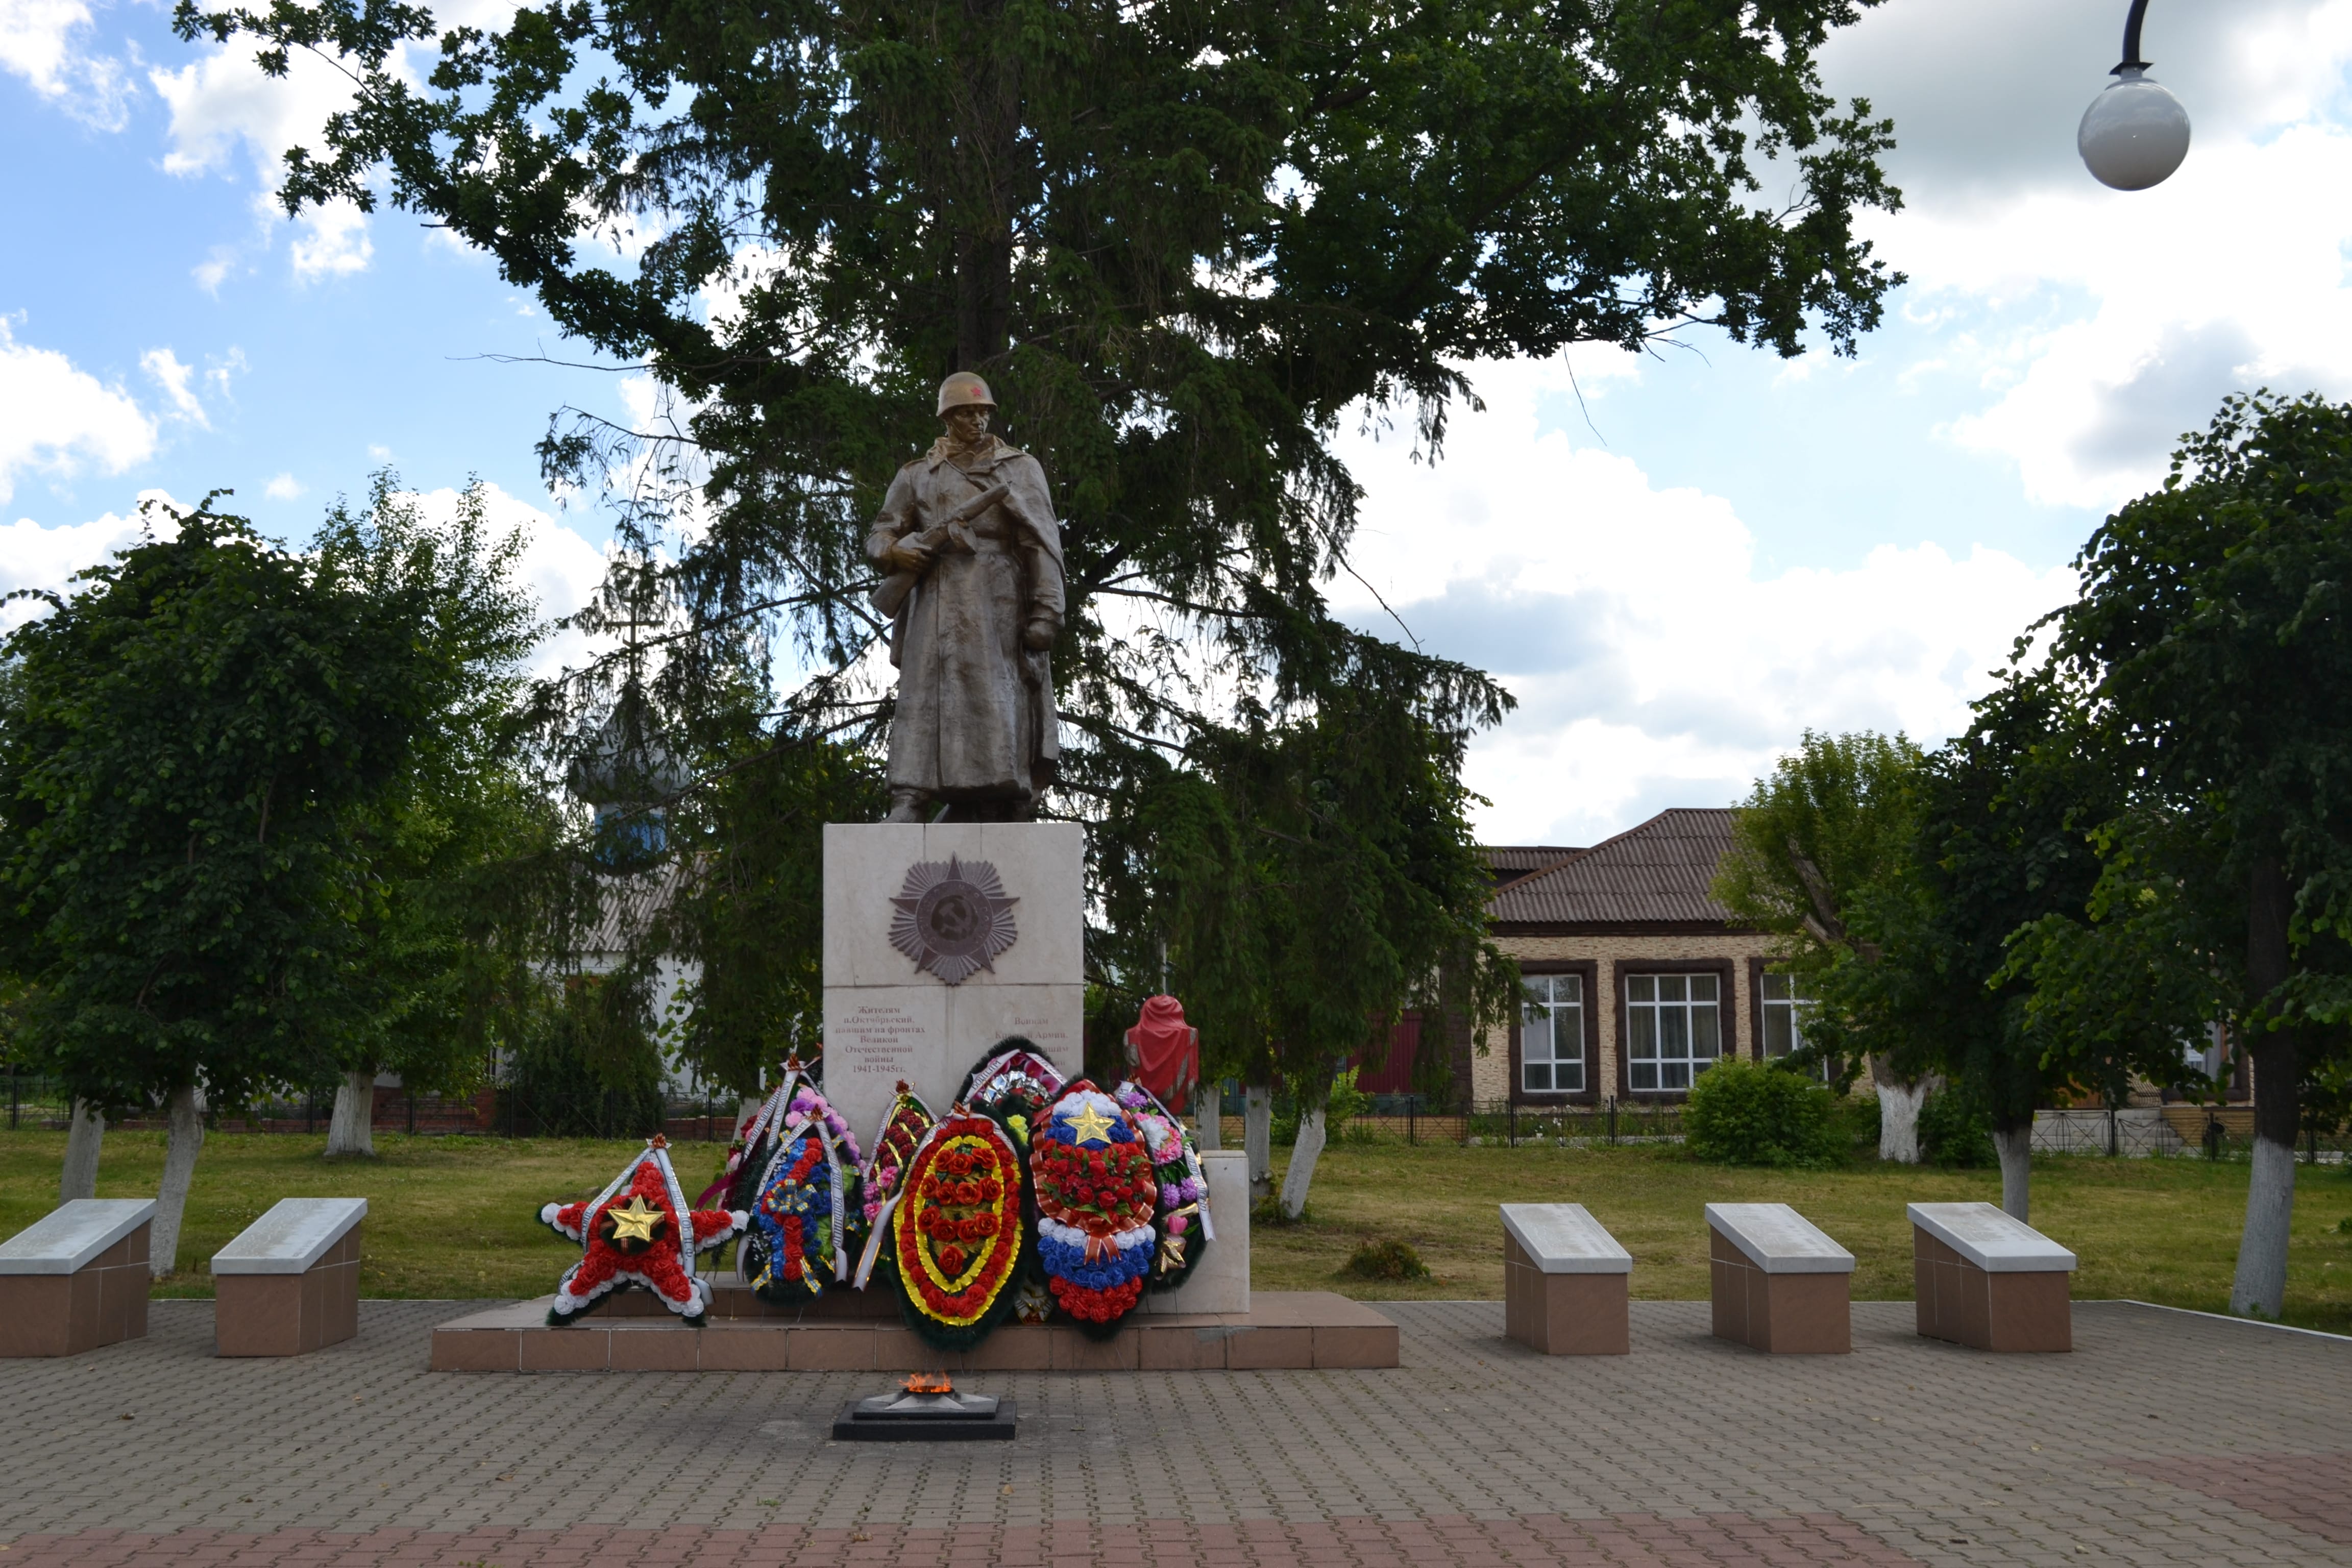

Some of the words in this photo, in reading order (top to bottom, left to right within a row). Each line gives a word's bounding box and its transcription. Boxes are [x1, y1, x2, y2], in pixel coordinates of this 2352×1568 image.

[858, 1006, 900, 1014] Жителям
[888, 1026, 925, 1035] фронтах
[845, 1045, 913, 1054] Отечественной
[971, 1061, 1001, 1090] ВОИНАМ
[832, 1196, 843, 1248] БОЛЬНИЦЫ
